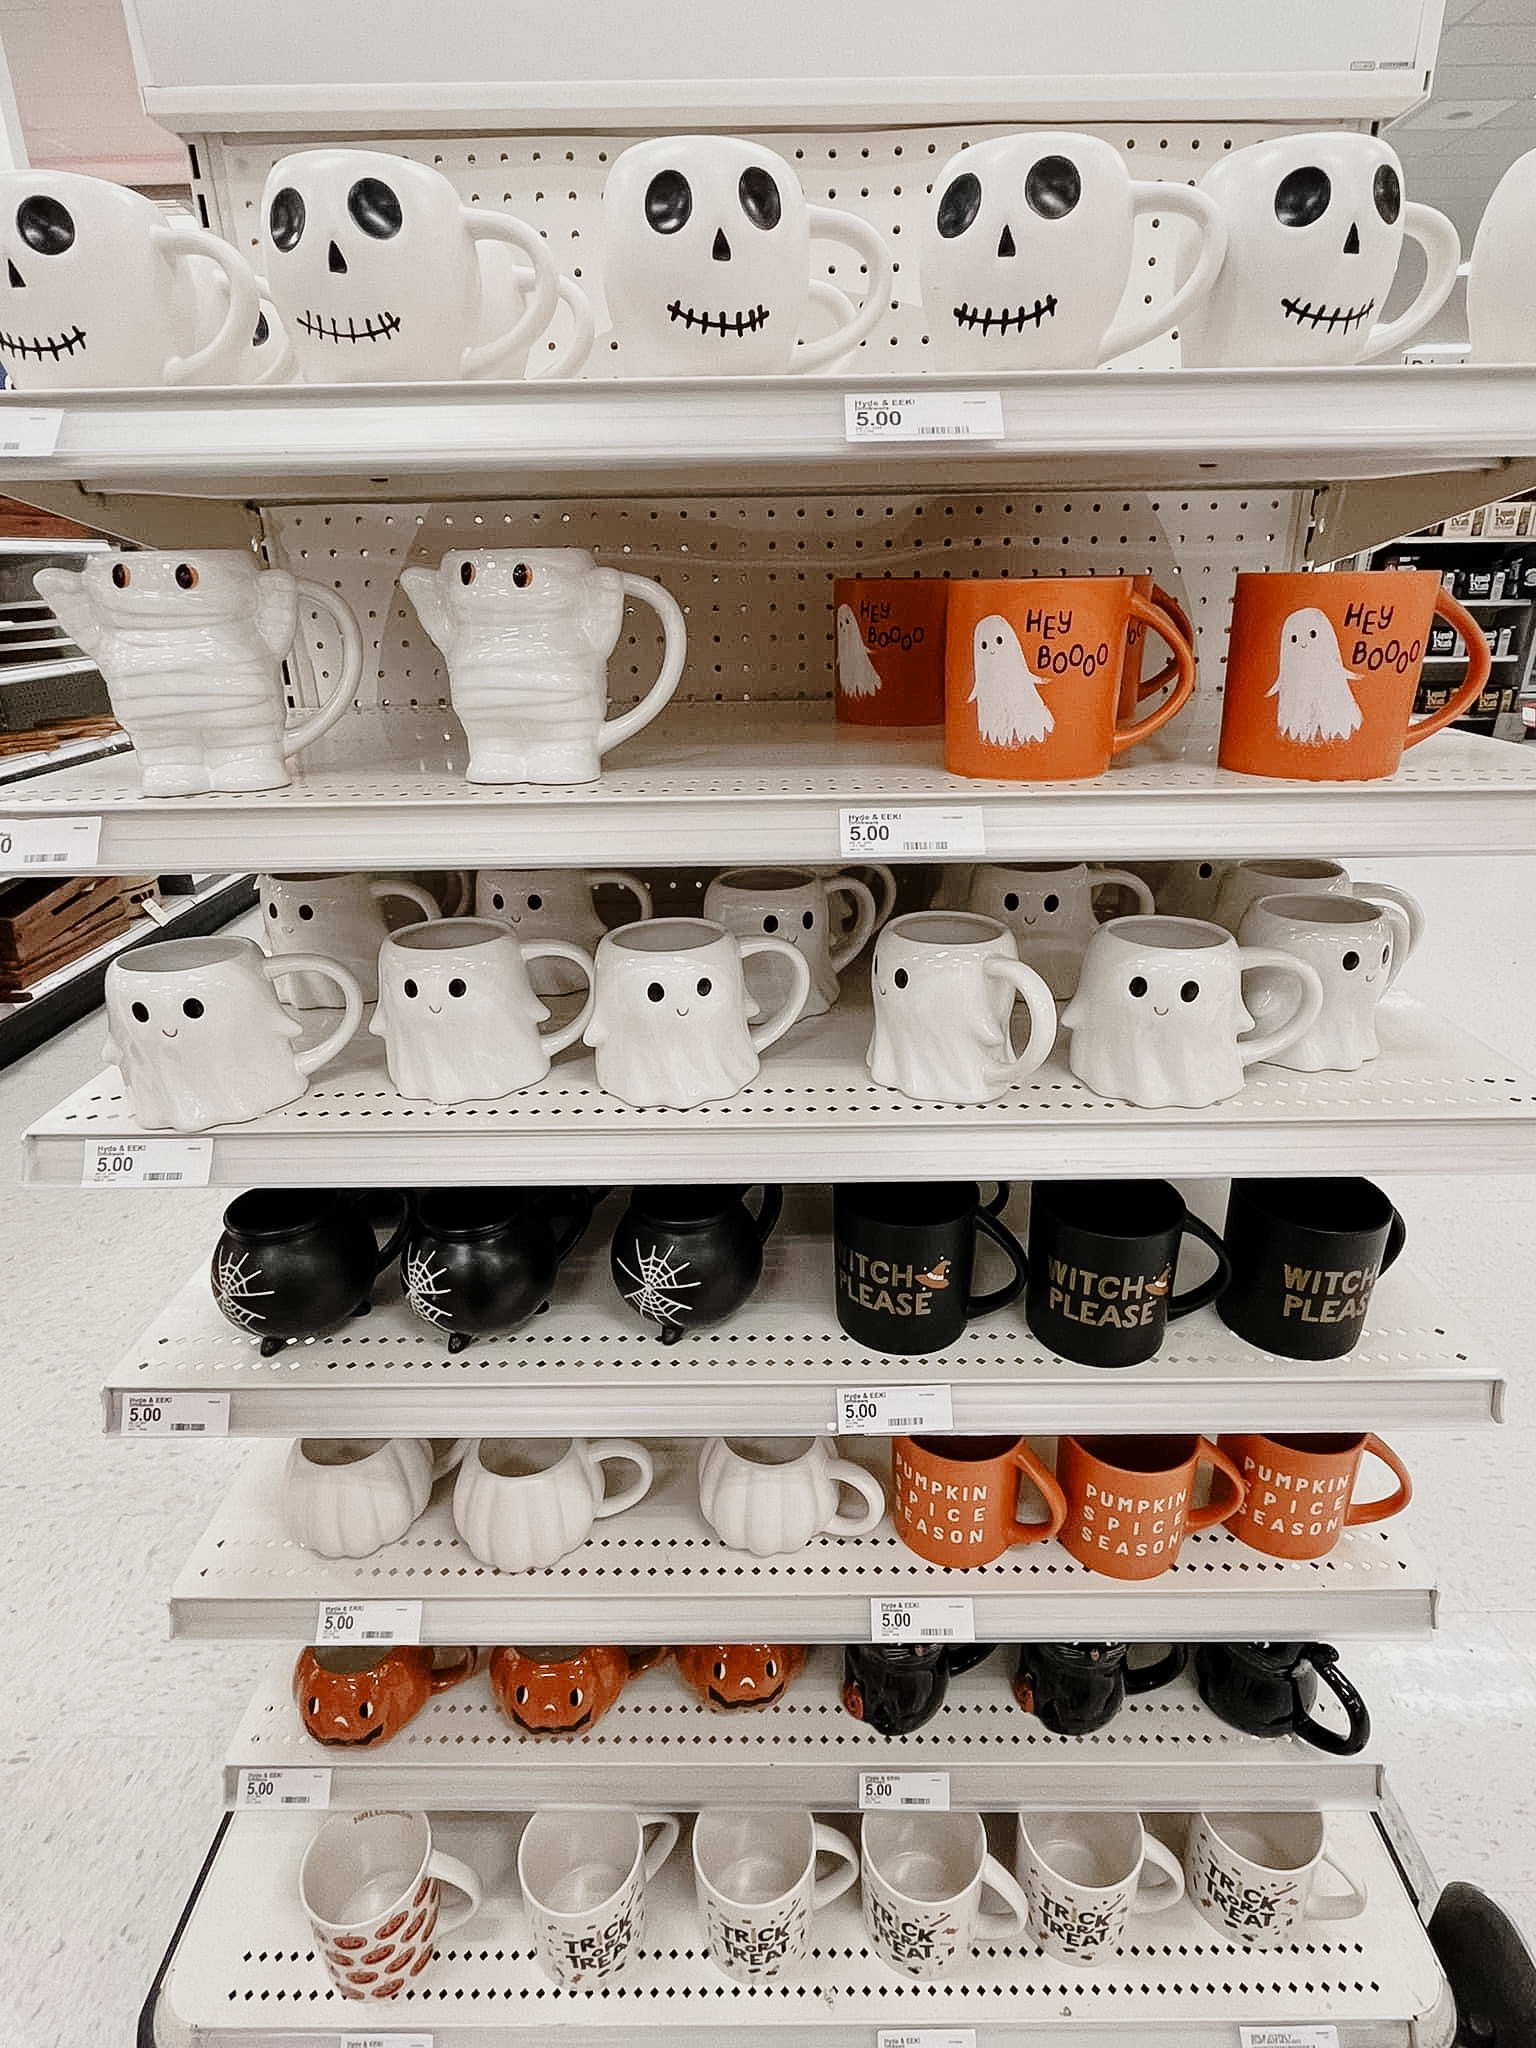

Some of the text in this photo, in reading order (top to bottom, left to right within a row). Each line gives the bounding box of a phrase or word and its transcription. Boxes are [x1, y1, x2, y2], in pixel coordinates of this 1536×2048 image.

[856, 410, 902, 427] 5.00
[860, 600, 891, 622] HEY
[1026, 609, 1073, 640] HEY
[1344, 602, 1395, 635] HEY
[1037, 643, 1109, 677] BOOOO
[1352, 639, 1421, 674] BOOOO
[849, 825, 890, 841] 5.00
[97, 1156, 134, 1172] 5.00
[841, 1247, 913, 1289] ITCH
[1284, 1263, 1378, 1296] WITCH
[1049, 1286, 1157, 1329] PLEASE
[1283, 1291, 1370, 1324] PLEAS
[129, 1407, 161, 1422] 5.00
[845, 1403, 877, 1418] 5.00
[1244, 1456, 1350, 1494] PUMPKIN
[1085, 1483, 1187, 1514] PUMPKIN
[1083, 1505, 1183, 1536] SPICE
[1081, 1526, 1179, 1557] SEASON
[324, 1615, 354, 1630] 5.00
[882, 1612, 911, 1627] 5.00
[247, 1782, 274, 1796] 5.00
[865, 1783, 892, 1796] 5.00
[1204, 1872, 1276, 1928] TREAT
[1038, 1905, 1110, 1947] TREAT
[721, 1936, 791, 1966] TREAT
